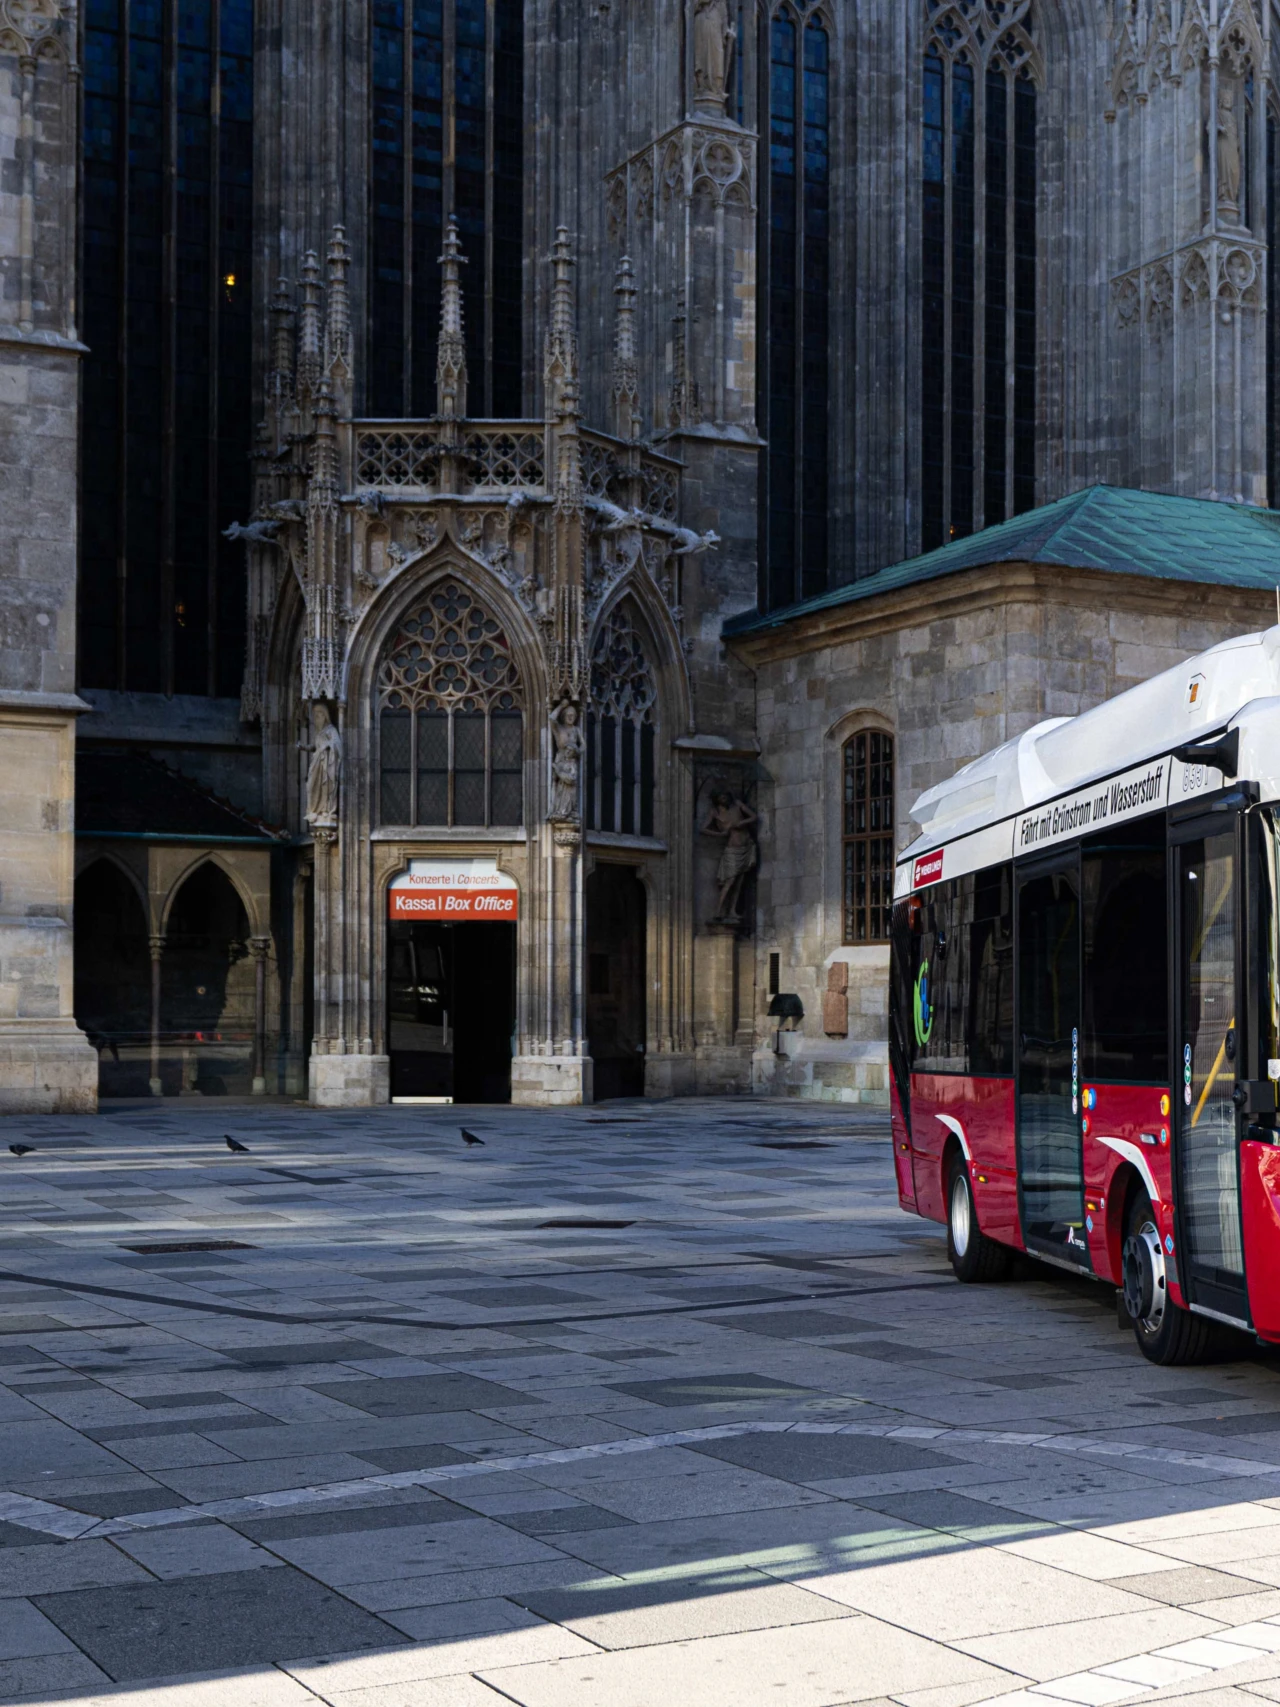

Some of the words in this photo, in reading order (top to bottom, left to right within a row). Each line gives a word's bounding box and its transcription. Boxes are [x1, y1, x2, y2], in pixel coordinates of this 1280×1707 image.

[1020, 815, 1039, 846] Fährt
[1039, 810, 1052, 840] mit
[1052, 800, 1092, 836] Grünstrom
[1093, 787, 1110, 821] und
[1110, 764, 1164, 816] Wasserstoff
[409, 874, 450, 884] Konzerte
[457, 874, 500, 884] Concerts
[395, 896, 436, 910] Kassa
[444, 896, 470, 910] Box
[474, 896, 513, 910] Office
